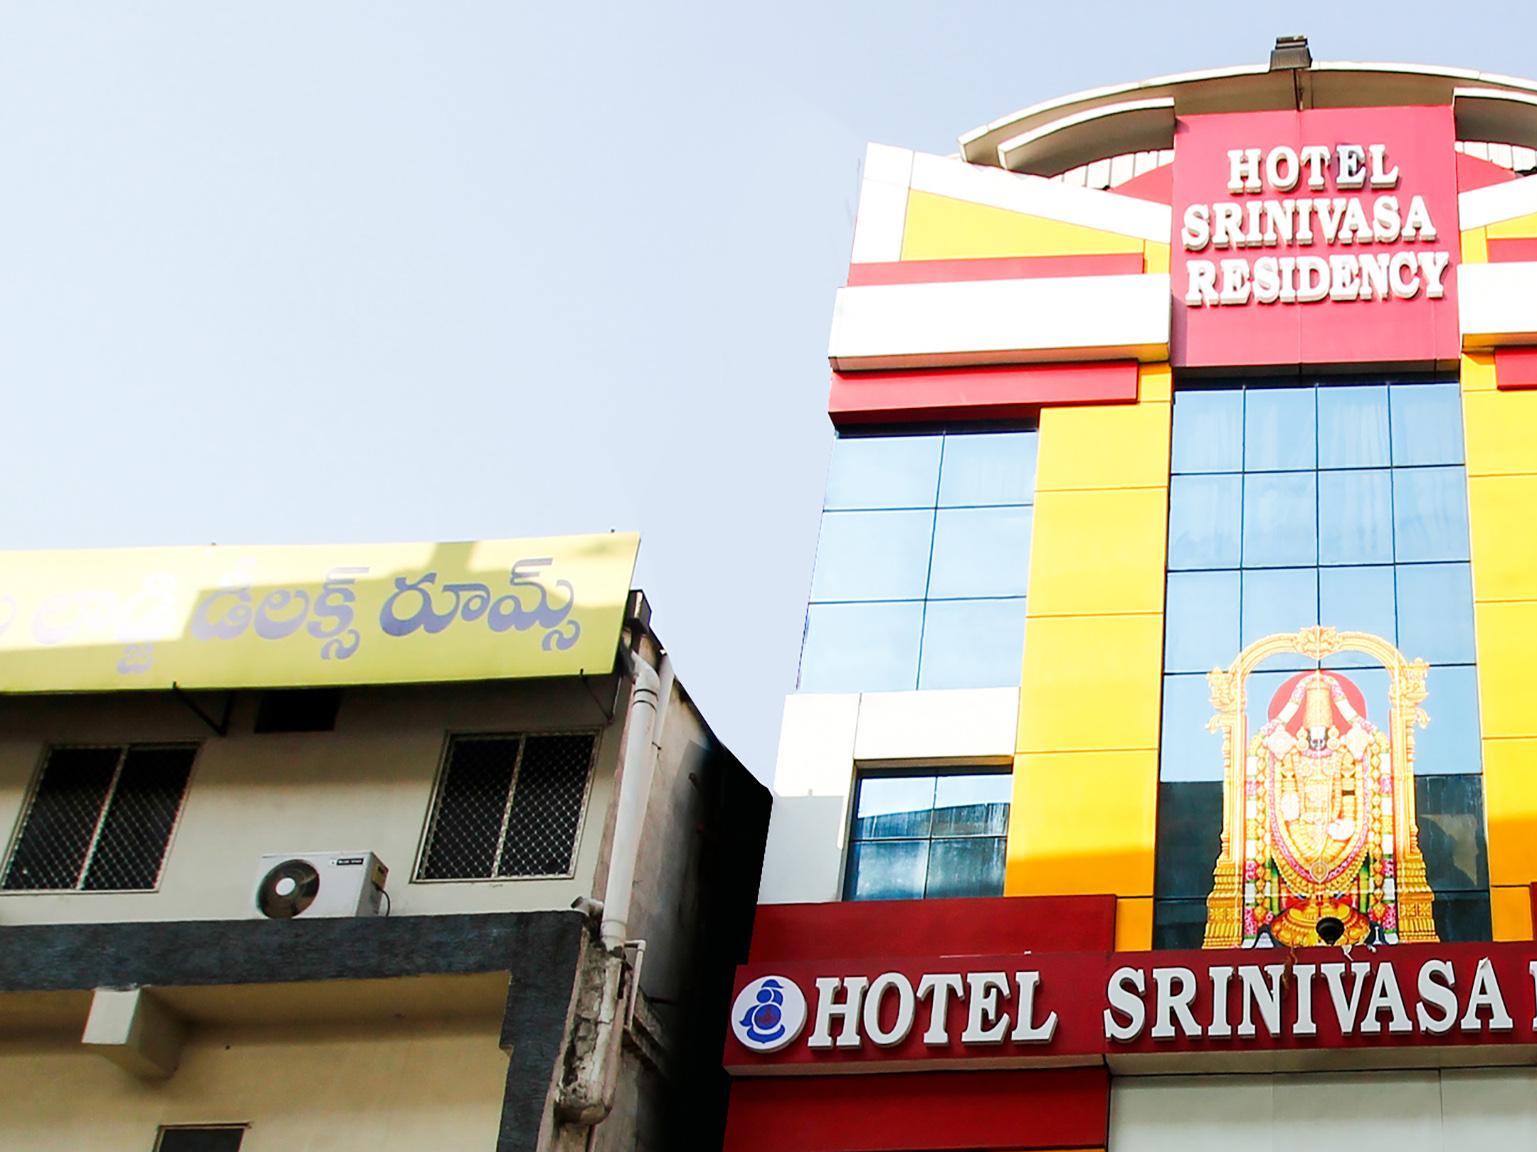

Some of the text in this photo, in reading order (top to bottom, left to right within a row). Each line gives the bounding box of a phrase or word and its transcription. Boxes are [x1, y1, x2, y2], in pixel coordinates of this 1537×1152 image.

[1227, 144, 1399, 194] HOTEL
[1182, 195, 1437, 251] SRINIVASA
[1185, 251, 1449, 309] RESIDENCY
[808, 971, 1058, 1050] HOTEL
[1104, 957, 1513, 1042] SRINIVASA
